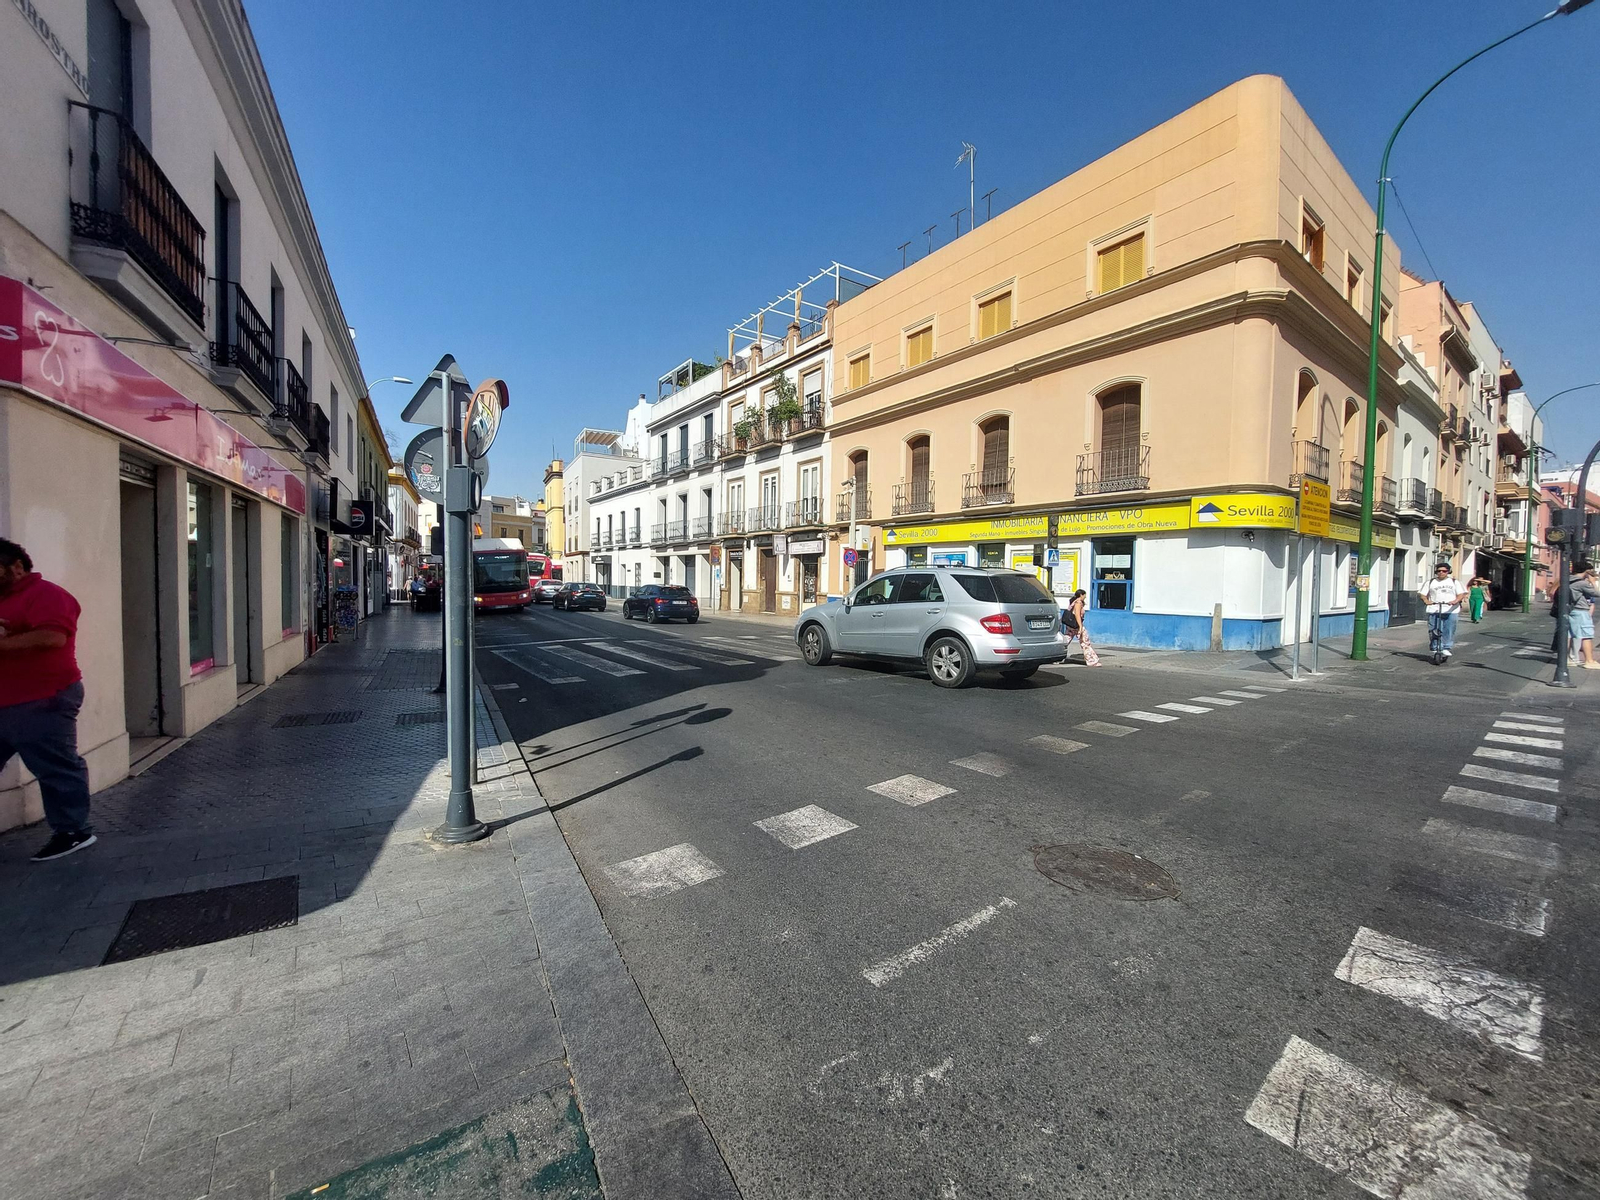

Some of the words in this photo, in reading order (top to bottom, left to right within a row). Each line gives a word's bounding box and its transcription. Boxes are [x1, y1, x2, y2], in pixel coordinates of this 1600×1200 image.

[1227, 504, 1275, 517] Sevilla
[990, 516, 1044, 529] INMOBILIARIA
[1059, 511, 1109, 523] NANCIERA
[1120, 508, 1143, 519] VPO
[1086, 523, 1125, 531] Promociones
[1126, 521, 1136, 529] de
[1137, 520, 1154, 528] Obra
[1155, 519, 1178, 528] Nueva
[898, 530, 919, 539] Sevilla
[920, 528, 938, 537] 2000
